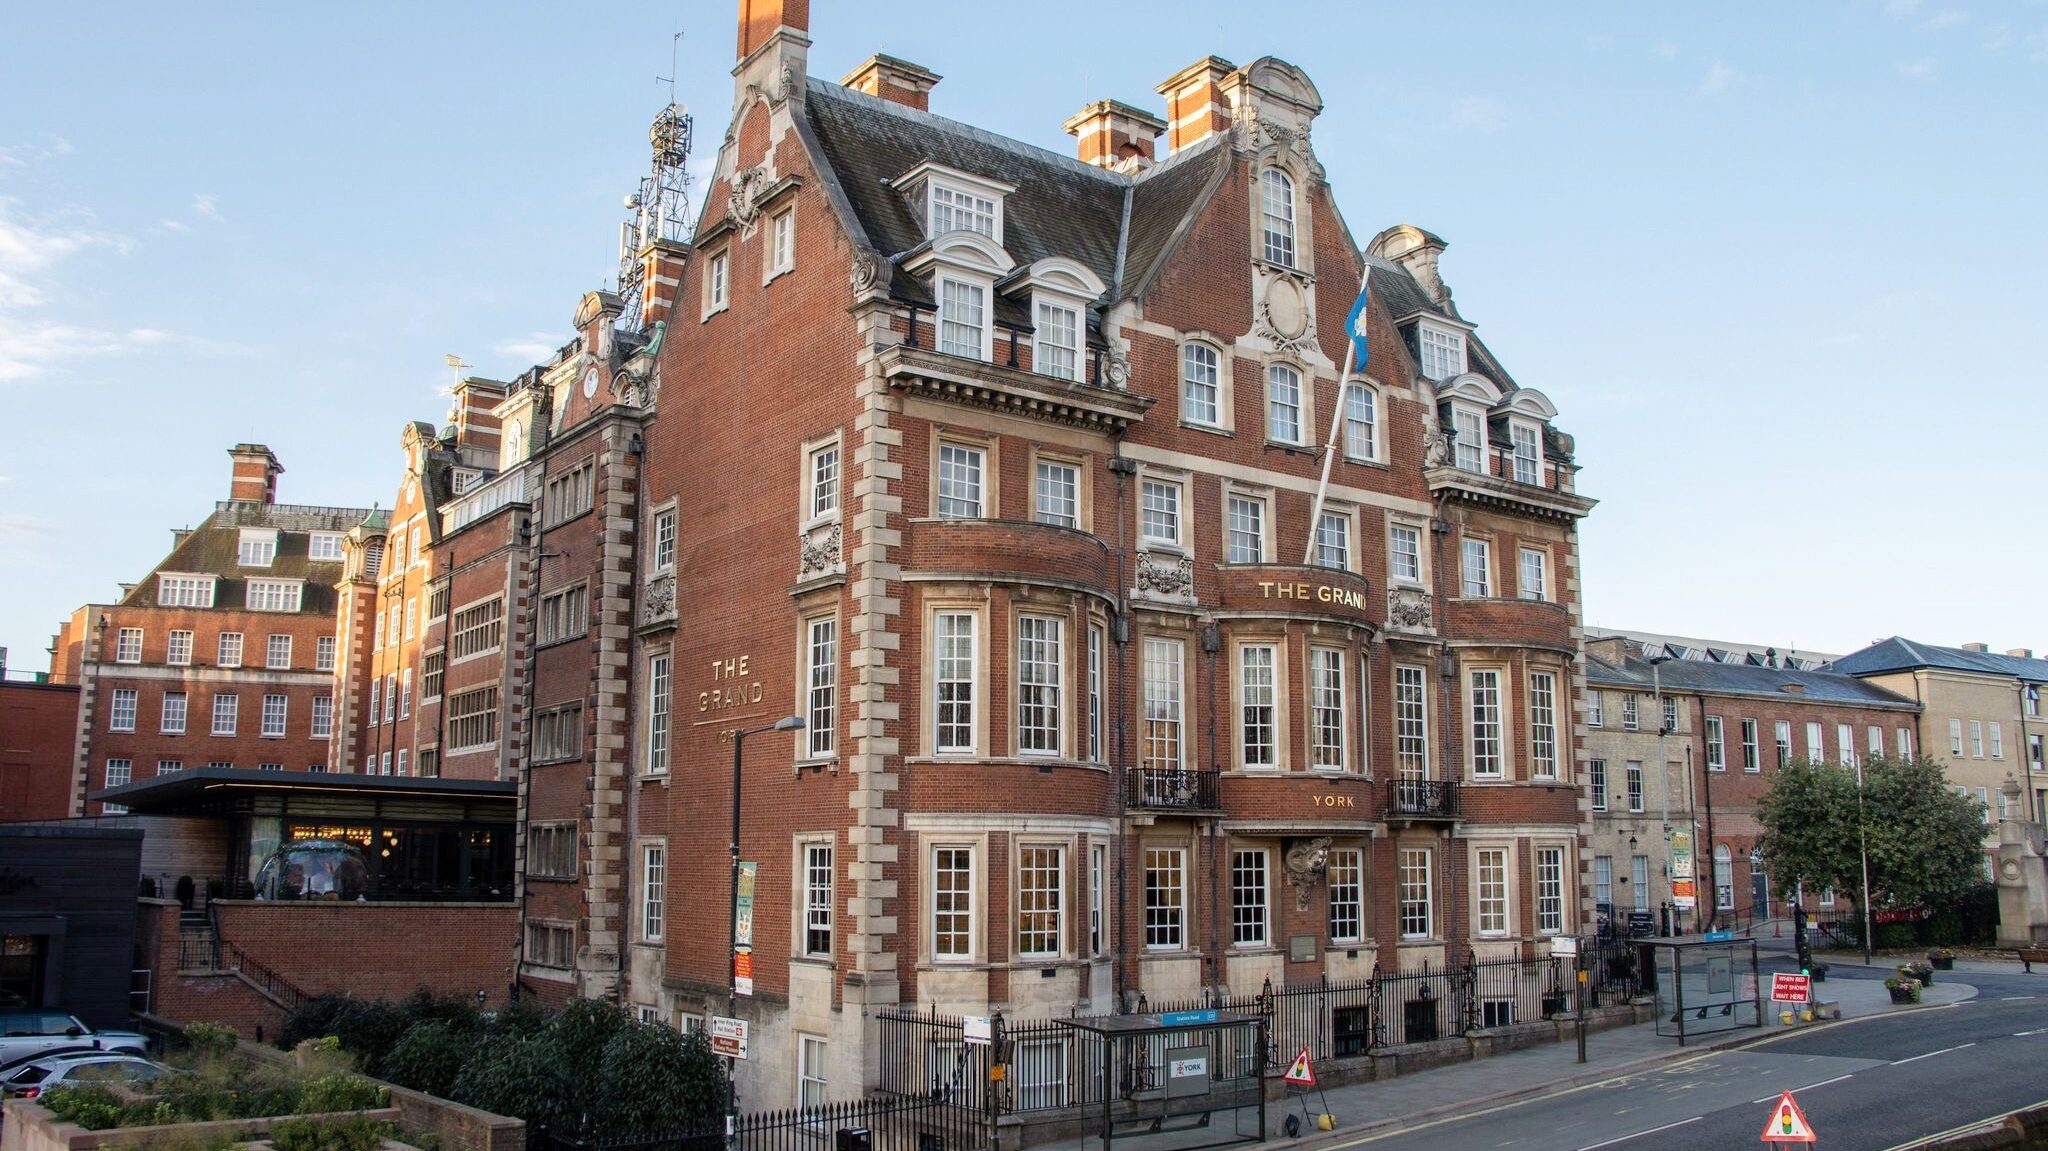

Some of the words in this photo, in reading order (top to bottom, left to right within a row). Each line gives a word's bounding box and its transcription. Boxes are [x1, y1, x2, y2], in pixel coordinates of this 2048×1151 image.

[1258, 582, 1310, 600] THE
[1317, 586, 1366, 611] GRAND
[712, 655, 749, 681] THE
[699, 682, 763, 712] GRAND
[1313, 795, 1354, 807] YORK
[1184, 1063, 1201, 1071] YORK
